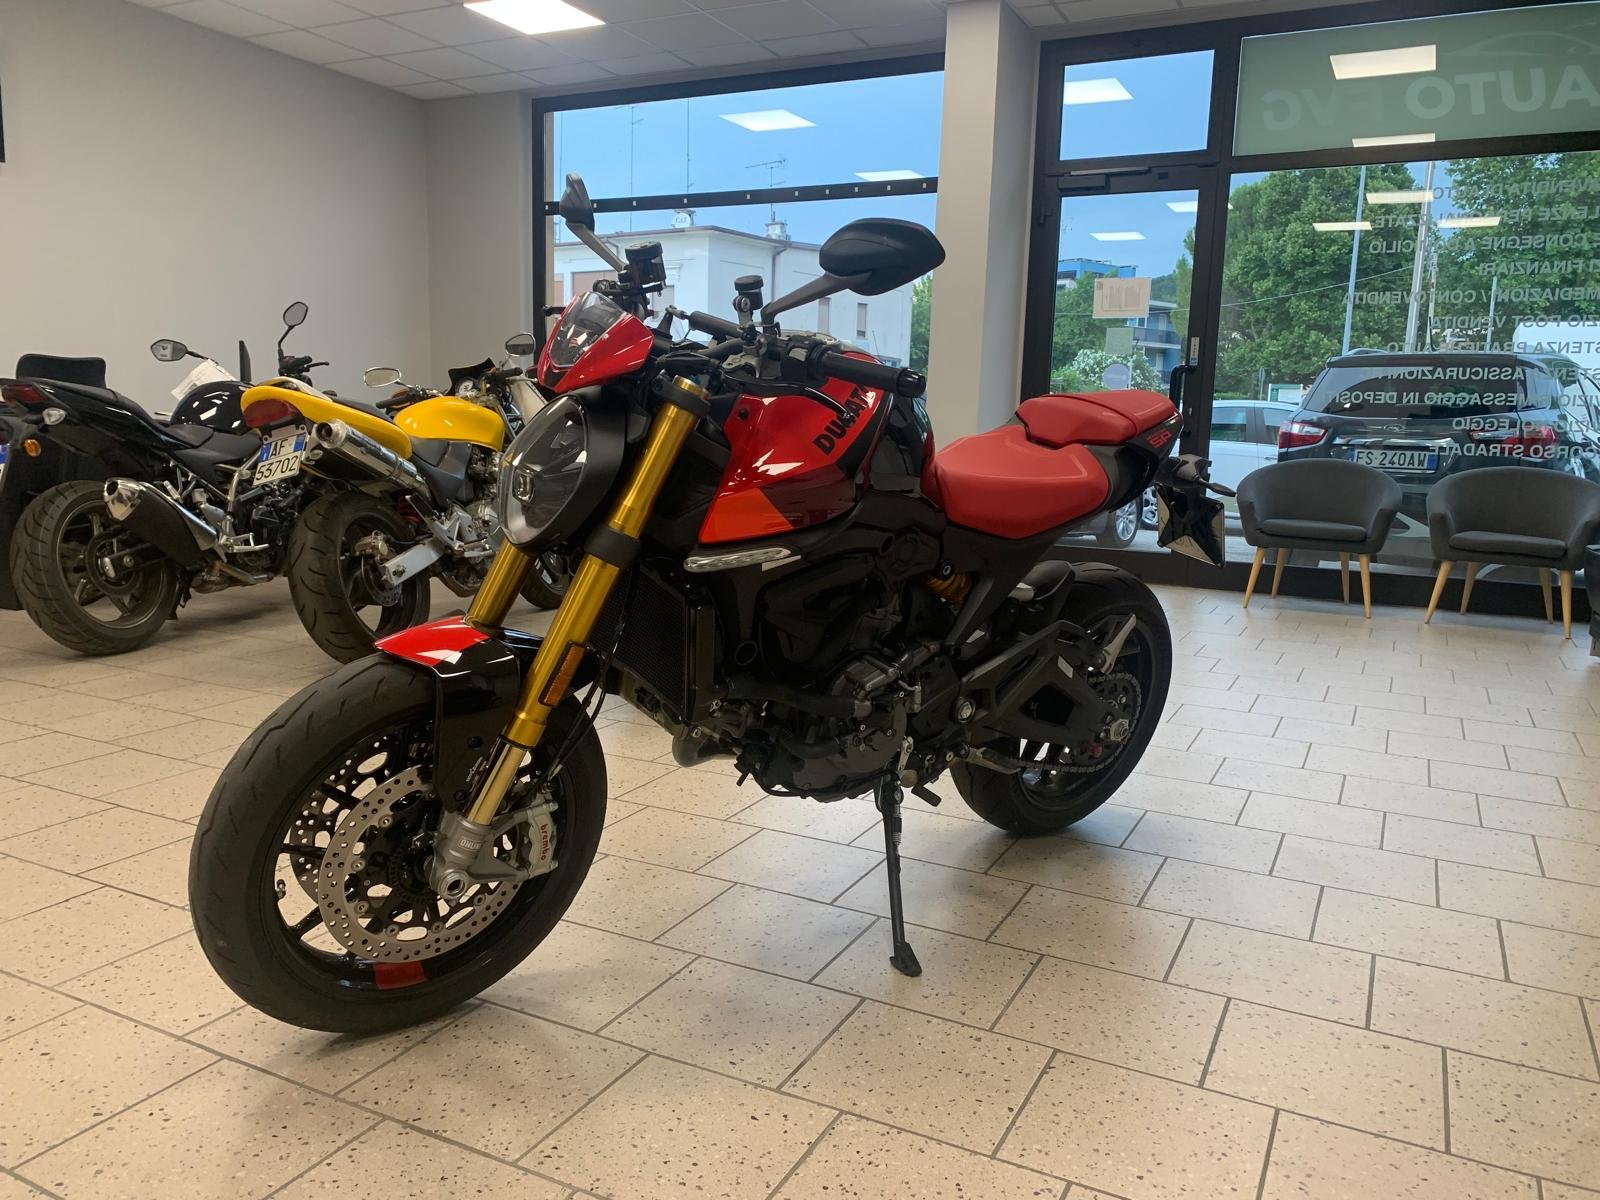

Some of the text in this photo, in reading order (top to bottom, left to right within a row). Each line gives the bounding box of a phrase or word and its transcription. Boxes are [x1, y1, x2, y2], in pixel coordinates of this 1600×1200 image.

[270, 438, 289, 458] AF
[1151, 430, 1172, 448] SP
[256, 455, 299, 481] 53702
[1379, 452, 1427, 467] 240AW
[540, 823, 551, 861] brembo
